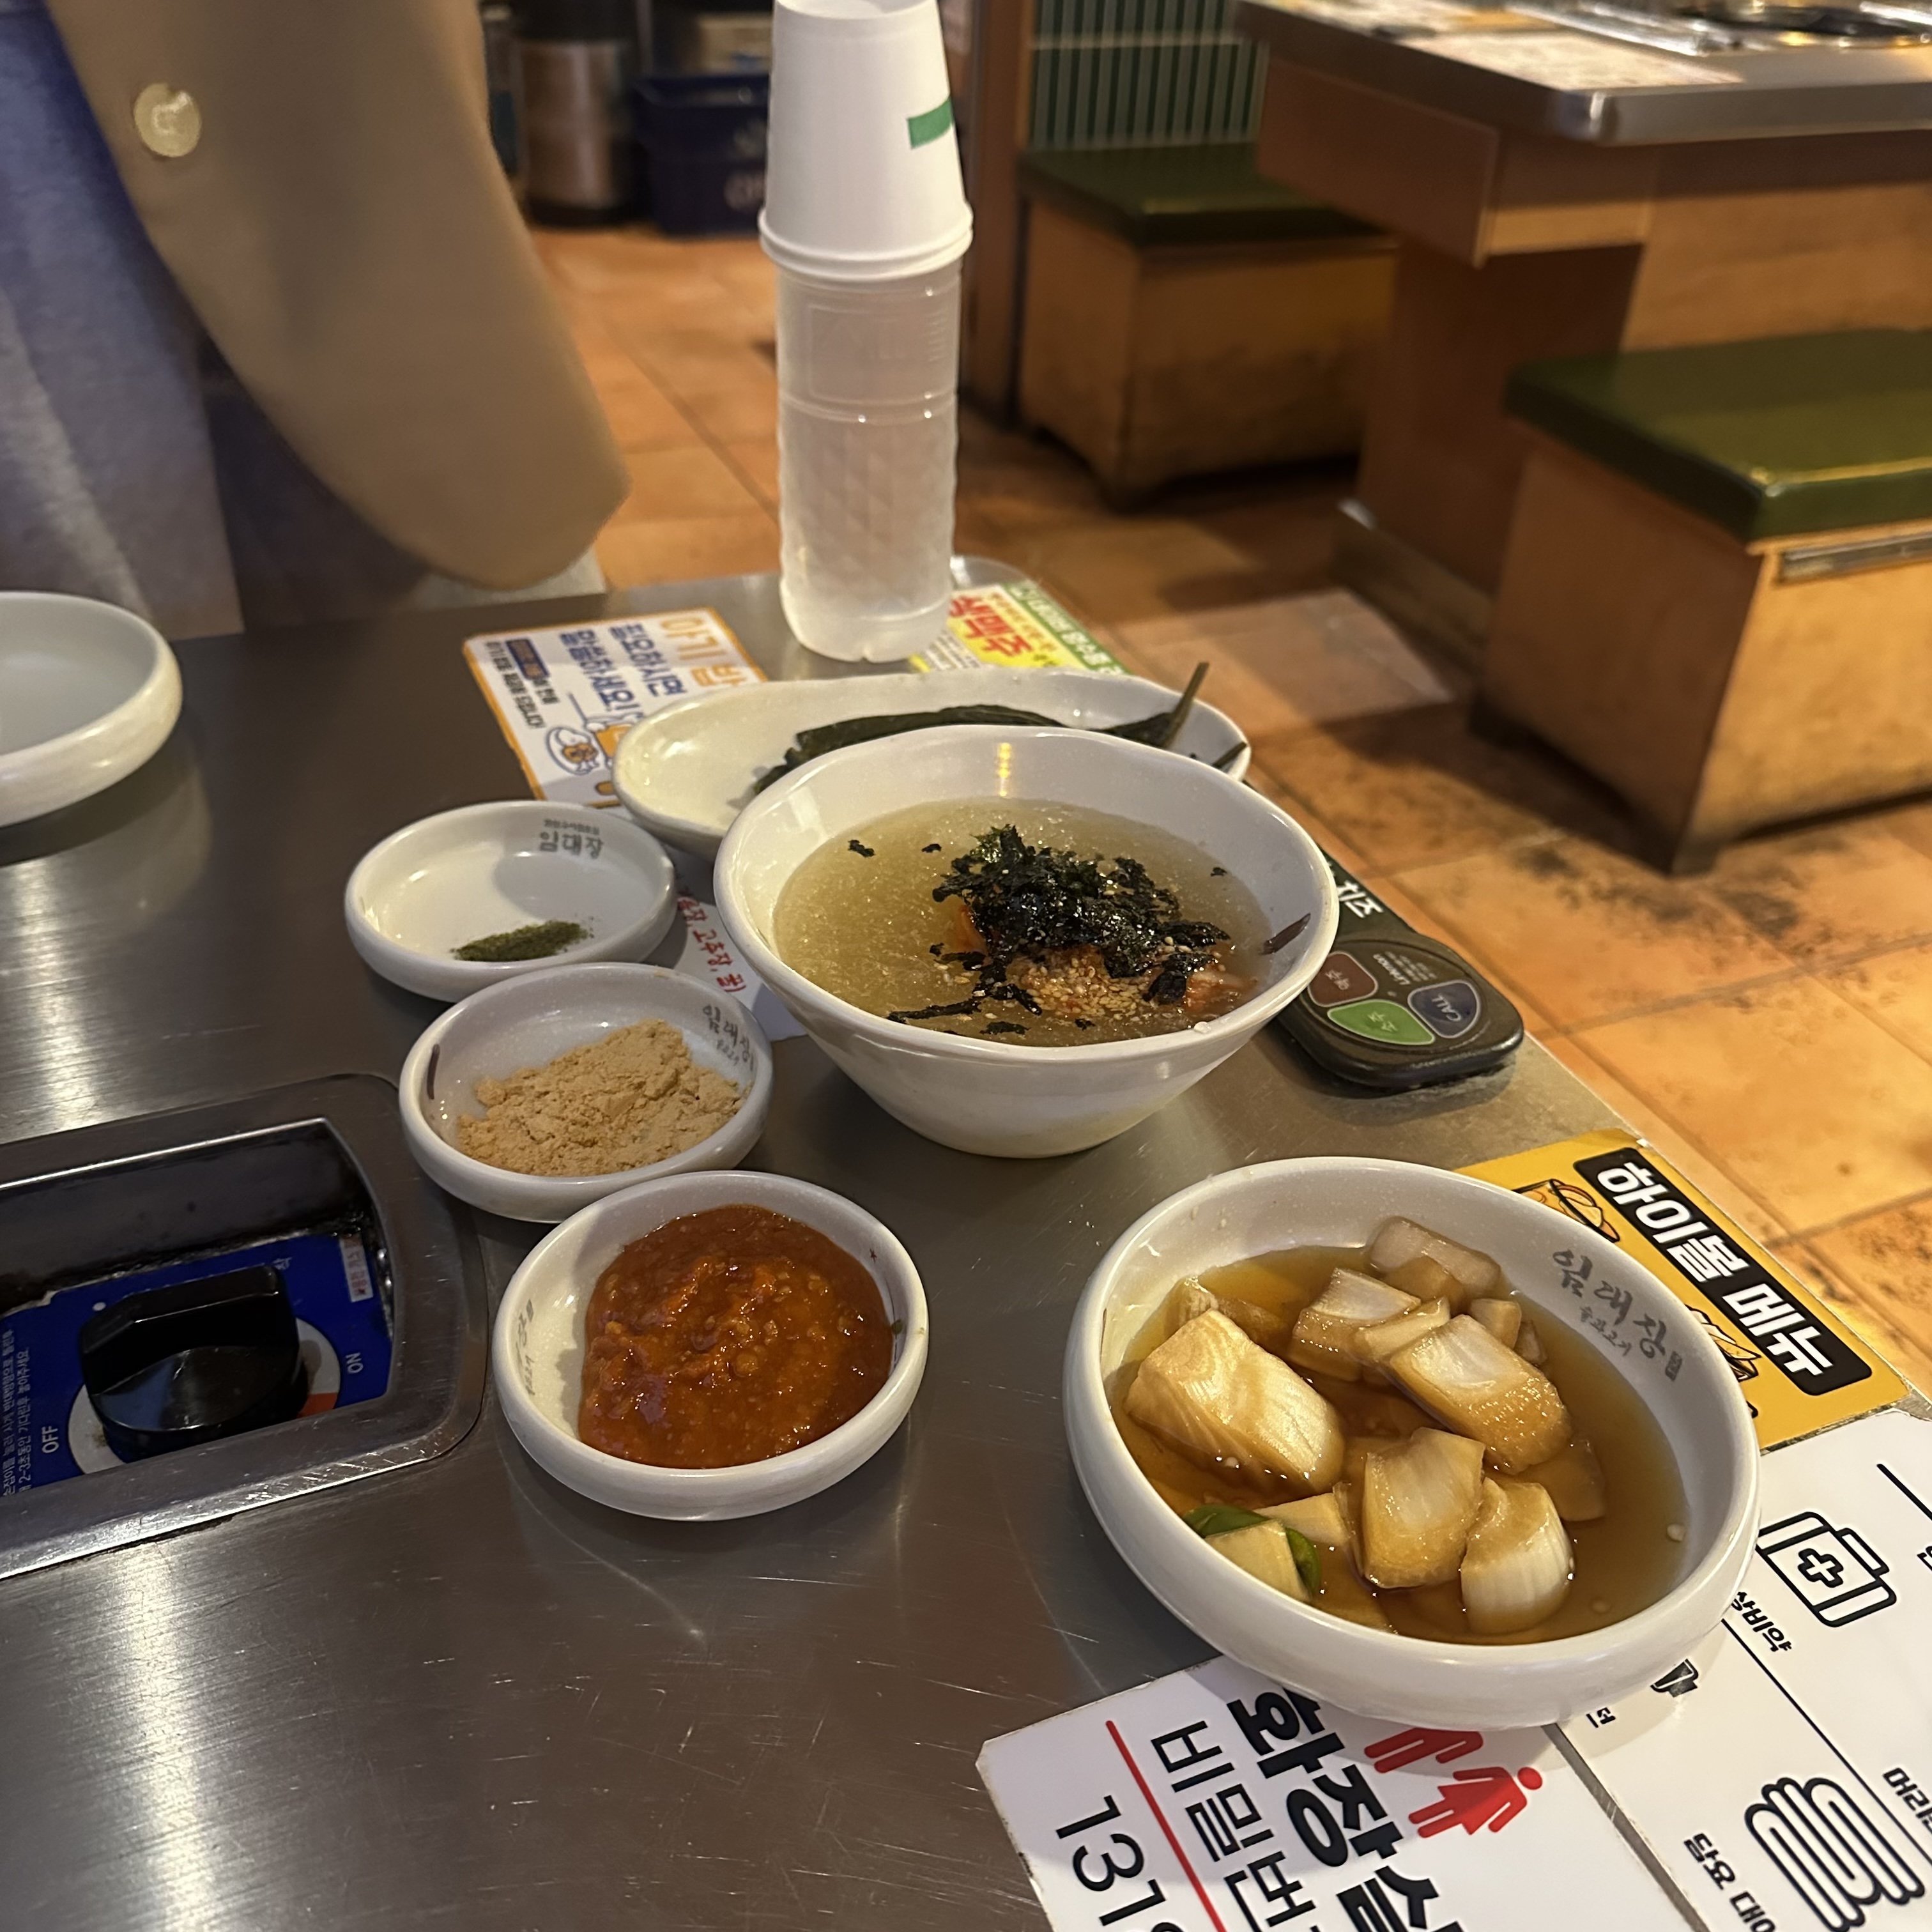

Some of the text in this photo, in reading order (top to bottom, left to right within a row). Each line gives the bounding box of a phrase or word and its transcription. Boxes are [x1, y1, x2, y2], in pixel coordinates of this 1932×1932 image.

[609, 624, 687, 696] 필요하시면
[539, 831, 604, 859] 임대장
[693, 929, 733, 972] 고추장,
[1368, 1011, 1397, 1032] 소주
[1432, 993, 1462, 1022] CALL
[1598, 1162, 1833, 1376] 하이볼 메뉴
[1552, 1250, 1667, 1360] 임대장
[345, 1352, 364, 1374] ON
[42, 1425, 59, 1453] OFF
[1731, 1591, 1792, 1652] 상비약
[1151, 1721, 1320, 1932] 비밀번
[1056, 1795, 1185, 1932] 131
[1683, 1833, 1735, 1890] 담요
